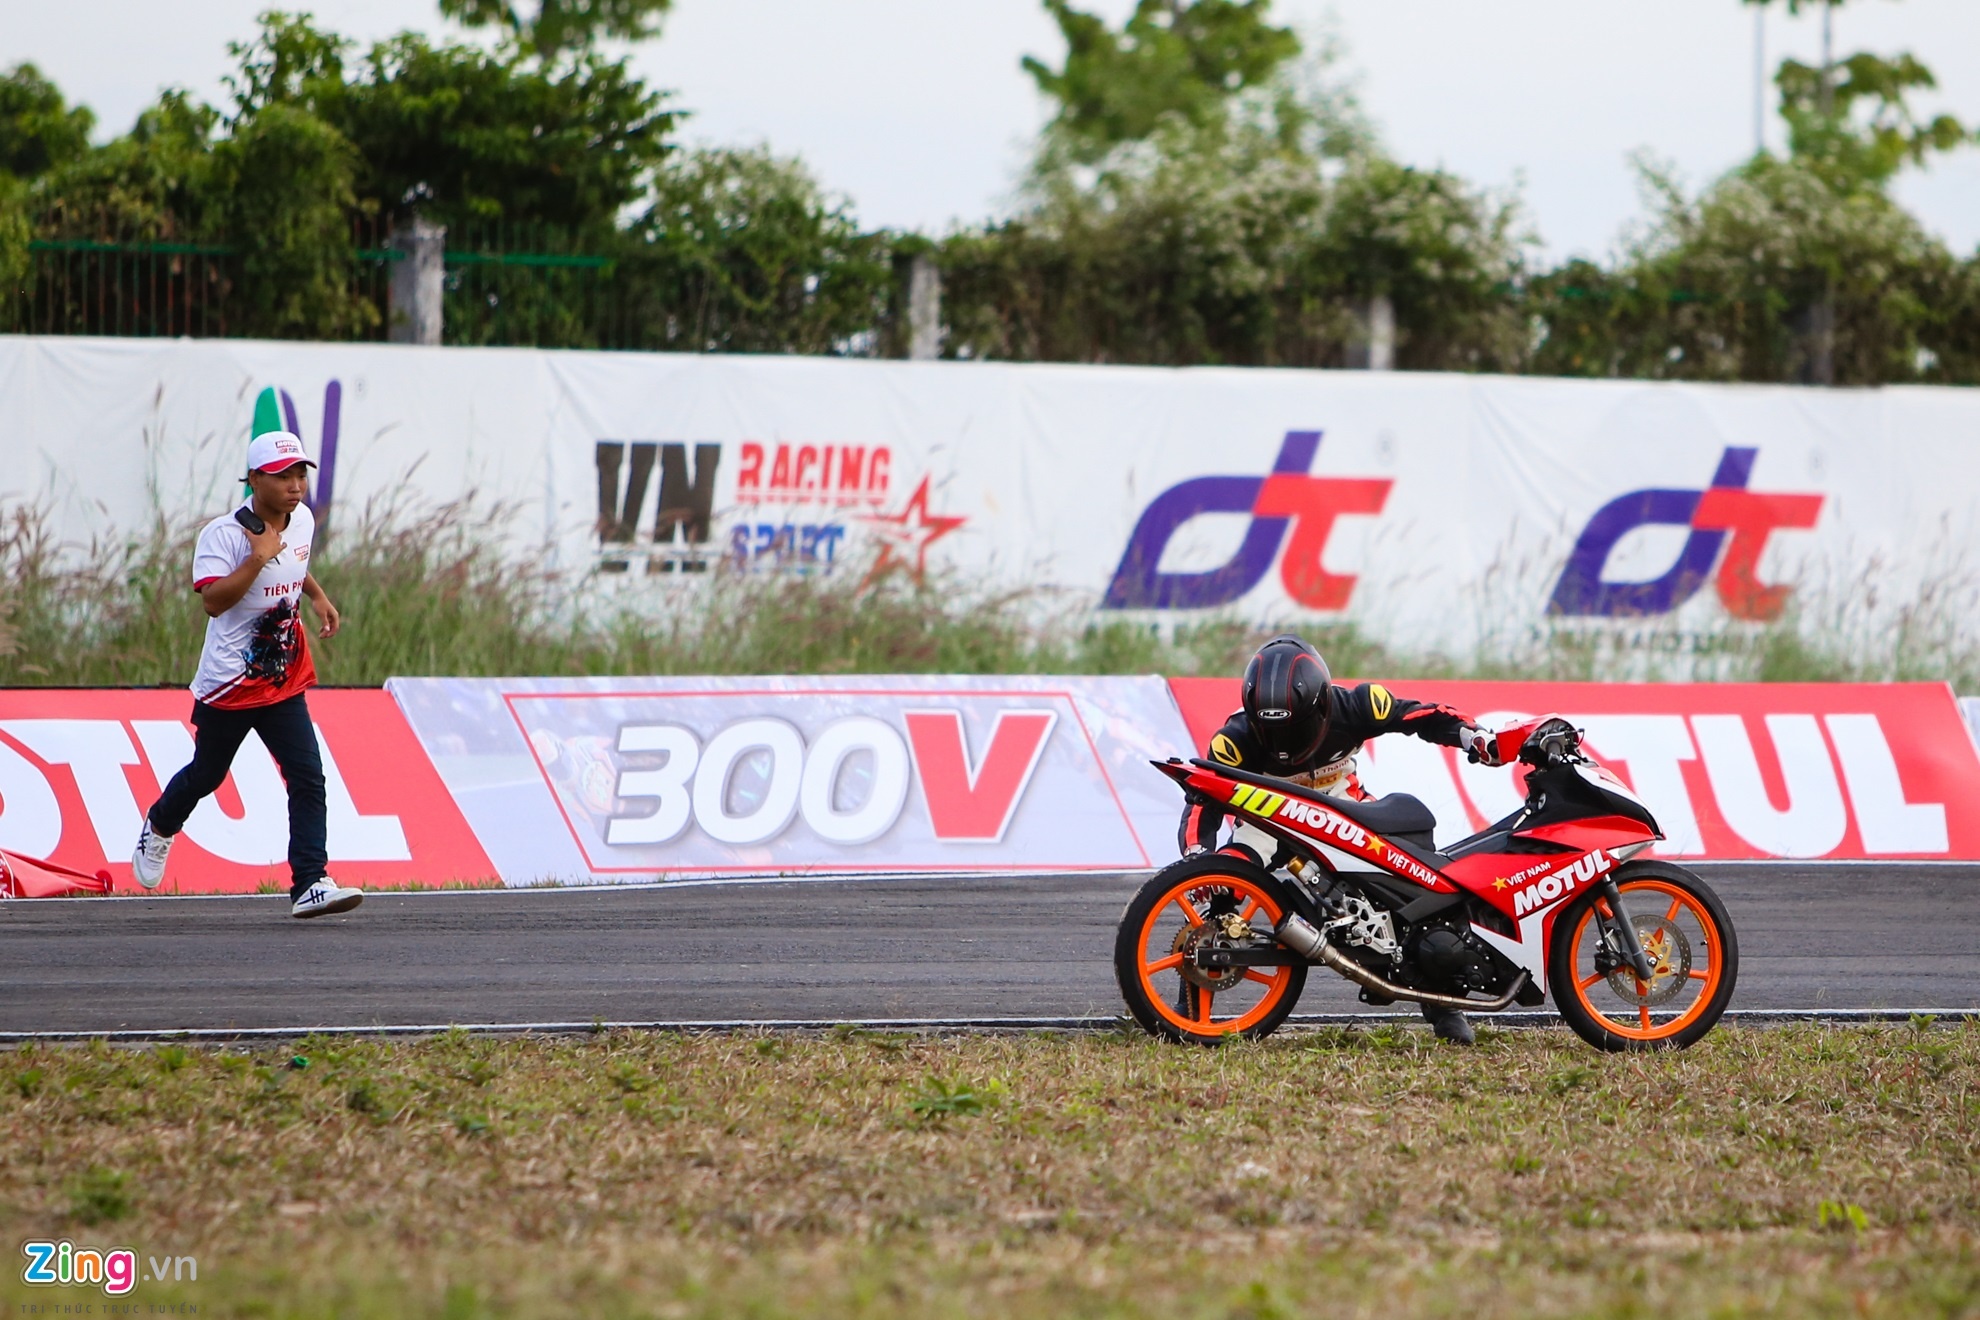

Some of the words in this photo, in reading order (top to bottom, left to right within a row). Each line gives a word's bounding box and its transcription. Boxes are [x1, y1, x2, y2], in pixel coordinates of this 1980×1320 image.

[737, 443, 890, 505] RACING
[596, 442, 722, 573] VN
[606, 706, 1057, 847] 300V
[1229, 783, 1287, 819] 10
[1279, 801, 1367, 847] MOTUL
[1410, 864, 1438, 886] NAM
[1513, 848, 1611, 917] MOTUL
[1526, 861, 1552, 877] NAM
